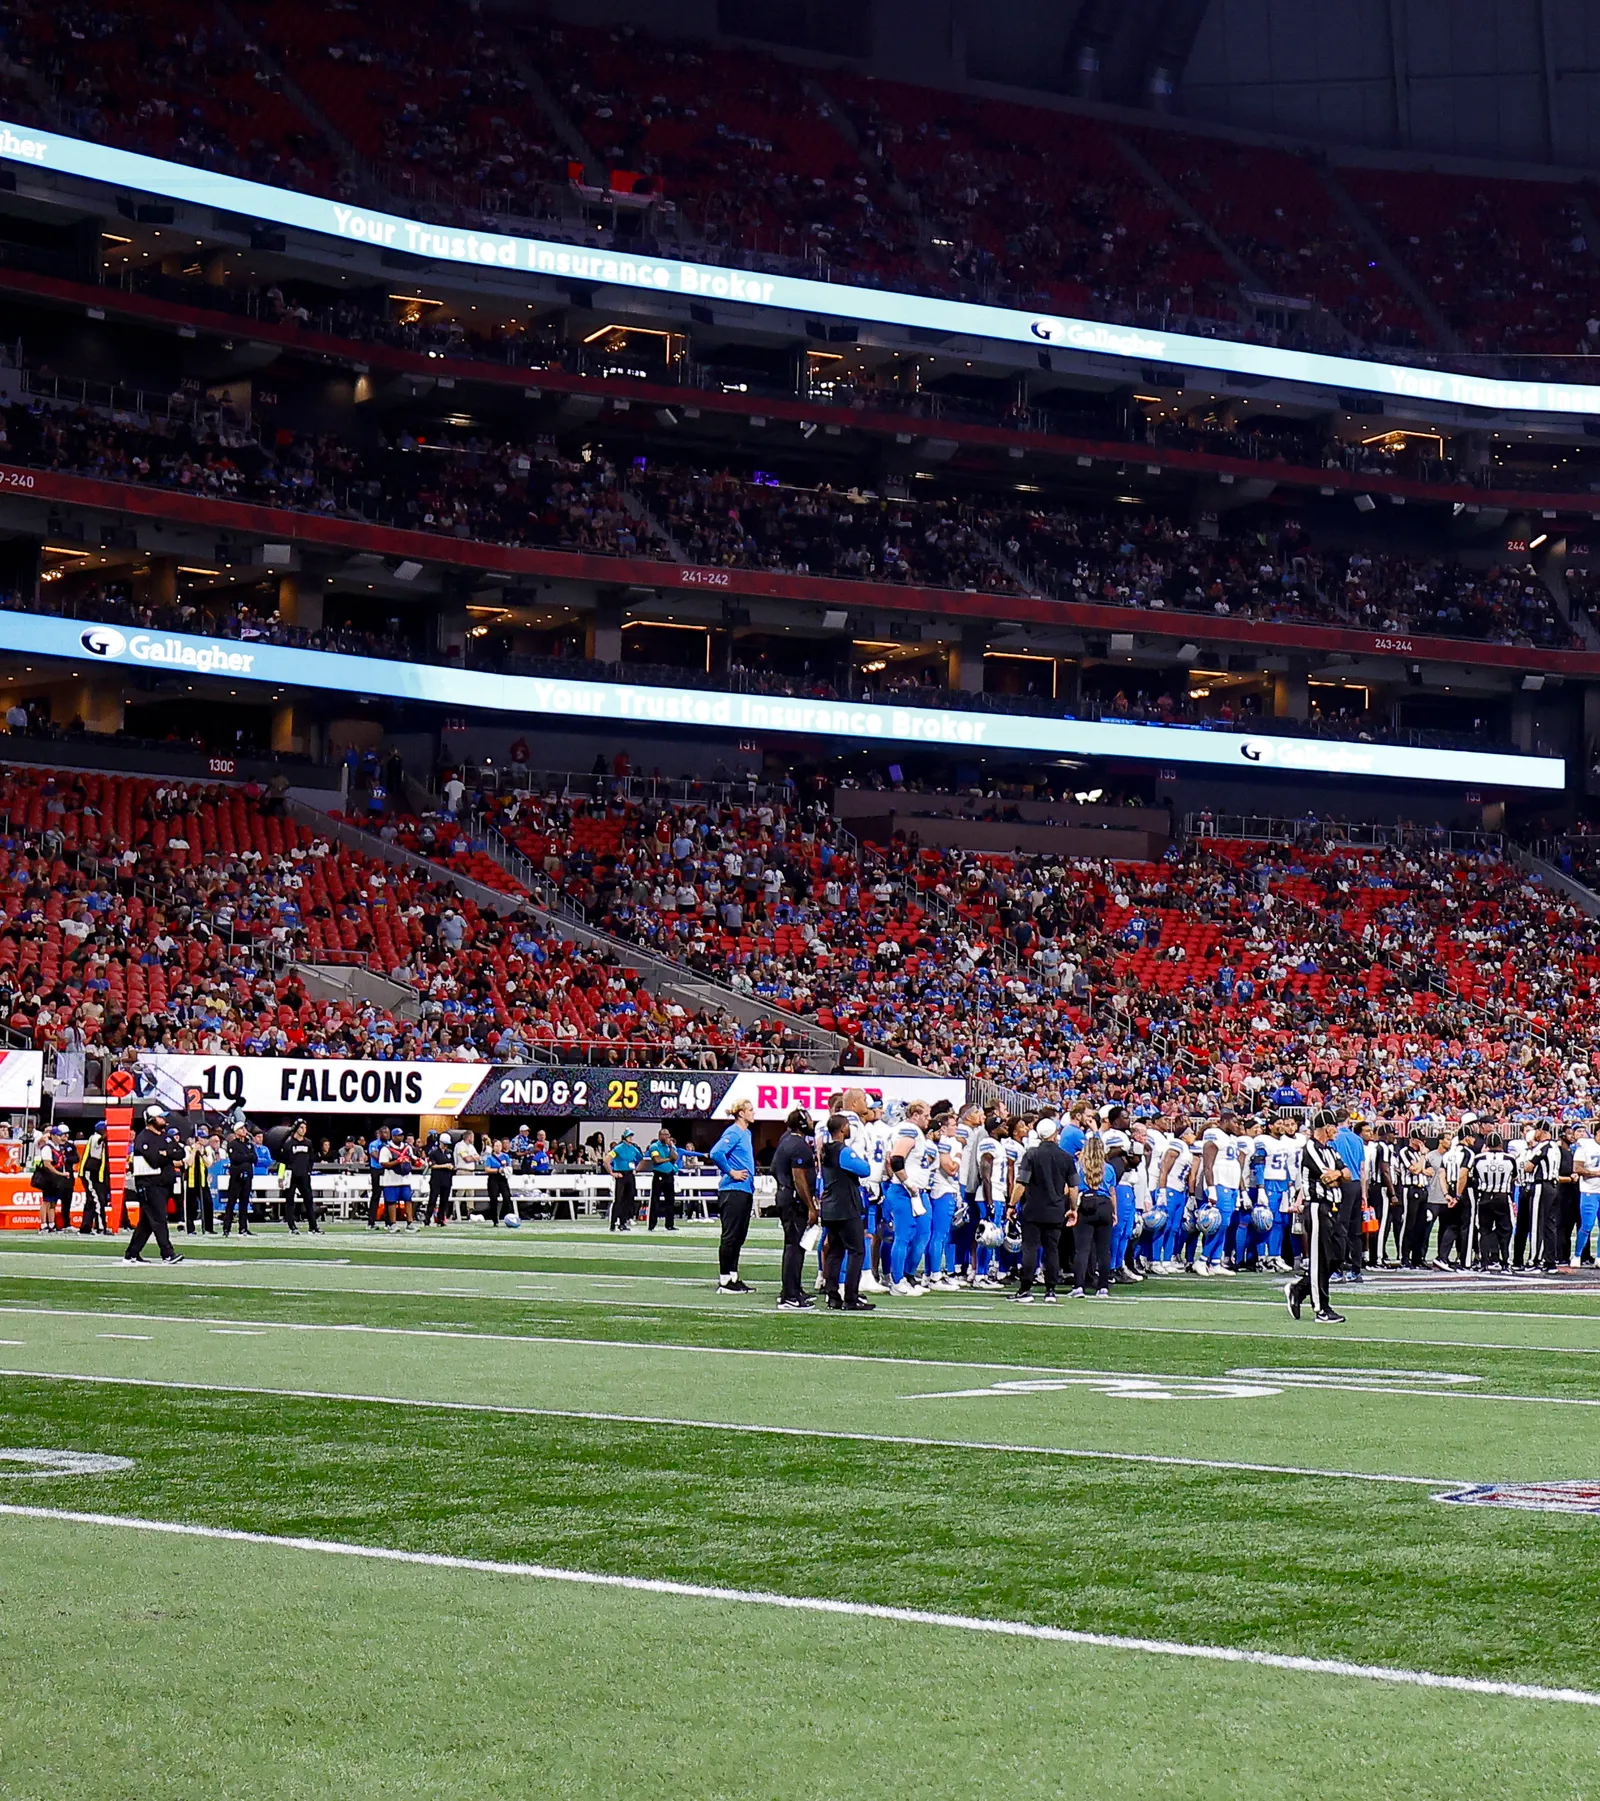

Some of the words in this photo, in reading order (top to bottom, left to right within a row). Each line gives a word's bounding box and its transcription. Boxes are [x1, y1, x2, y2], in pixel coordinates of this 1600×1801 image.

[333, 205, 396, 244] Your
[404, 224, 517, 266] Trusted
[528, 247, 670, 287] Insurance
[680, 266, 775, 301] Broker
[1067, 324, 1166, 357] Gallagher
[260, 391, 278, 404] 241
[1389, 368, 1443, 396] Your
[1449, 377, 1540, 407] Trusted
[1508, 540, 1525, 552] 244
[681, 569, 731, 588] 241-242
[129, 634, 255, 674] Gallagher
[1374, 637, 1413, 652] 243-244
[534, 681, 606, 714] Your
[616, 688, 731, 723] Trusted
[742, 699, 883, 735] Insurance
[893, 711, 987, 742] Broker
[445, 718, 467, 731] 131
[738, 739, 757, 752] 131
[1277, 742, 1373, 771] Gallagher
[208, 758, 235, 774] 130C
[281, 1068, 423, 1104] FALCONS
[500, 1079, 549, 1105] 2ND
[552, 1079, 570, 1105] &
[573, 1080, 588, 1106] 2
[607, 1080, 639, 1110] 25
[650, 1079, 678, 1094] BALL
[679, 1080, 712, 1111] 49
[757, 1084, 829, 1110] RISE
[188, 1087, 202, 1111] 2
[661, 1096, 678, 1110] ON
[1485, 1164, 1505, 1174] 106
